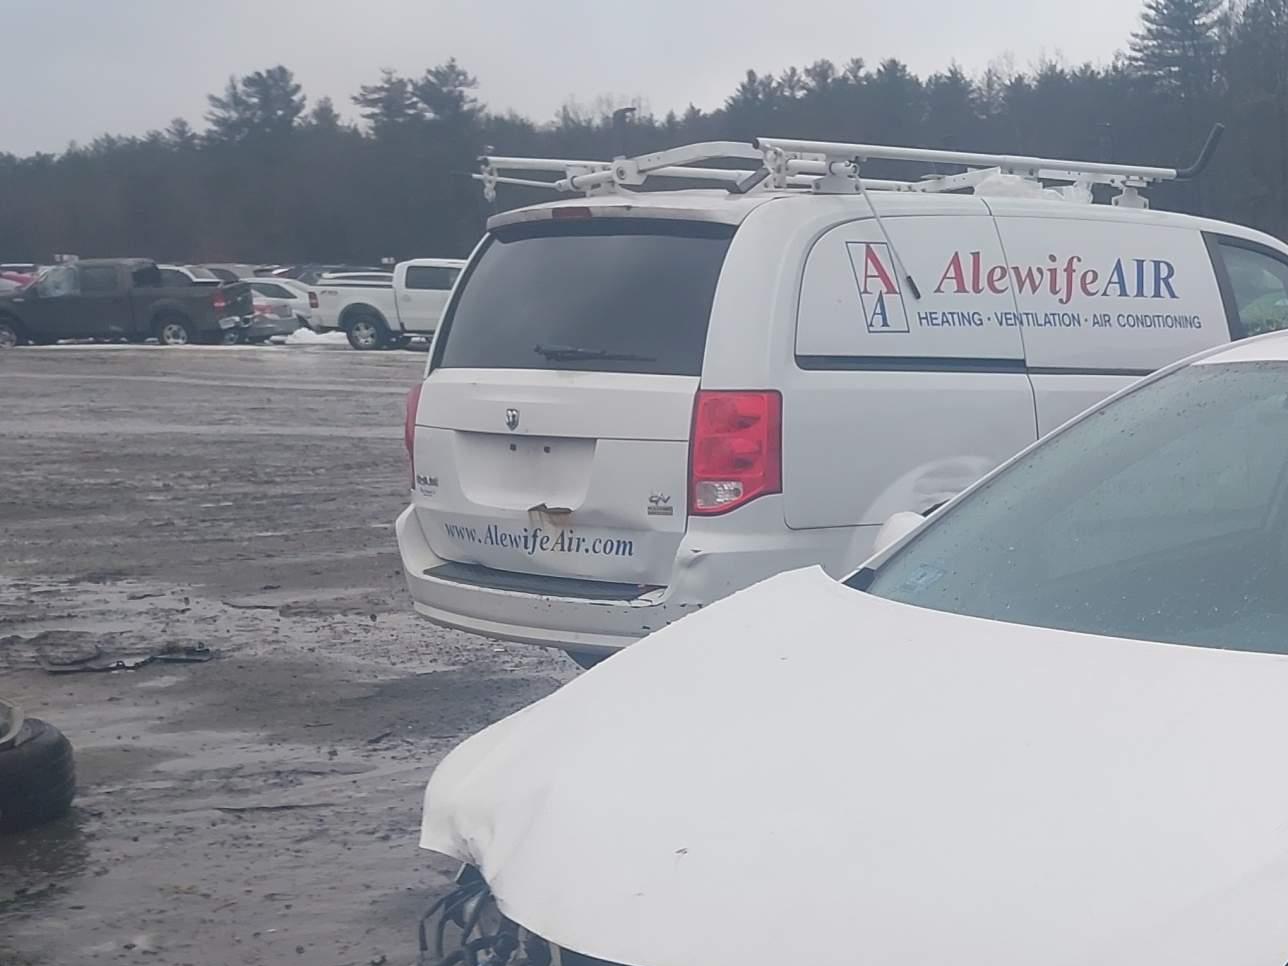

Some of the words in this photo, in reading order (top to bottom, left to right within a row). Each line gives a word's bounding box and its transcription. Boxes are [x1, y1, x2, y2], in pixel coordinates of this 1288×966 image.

[861, 242, 900, 294] A
[933, 251, 1180, 305] AlewifeAIR
[869, 290, 890, 327] A
[918, 311, 983, 327] HEATING
[994, 312, 1081, 328] VENTILATION
[1092, 314, 1112, 328] AIR
[1117, 314, 1201, 329] CONDITIONING
[445, 523, 634, 556] www.AlewifeAir.com
